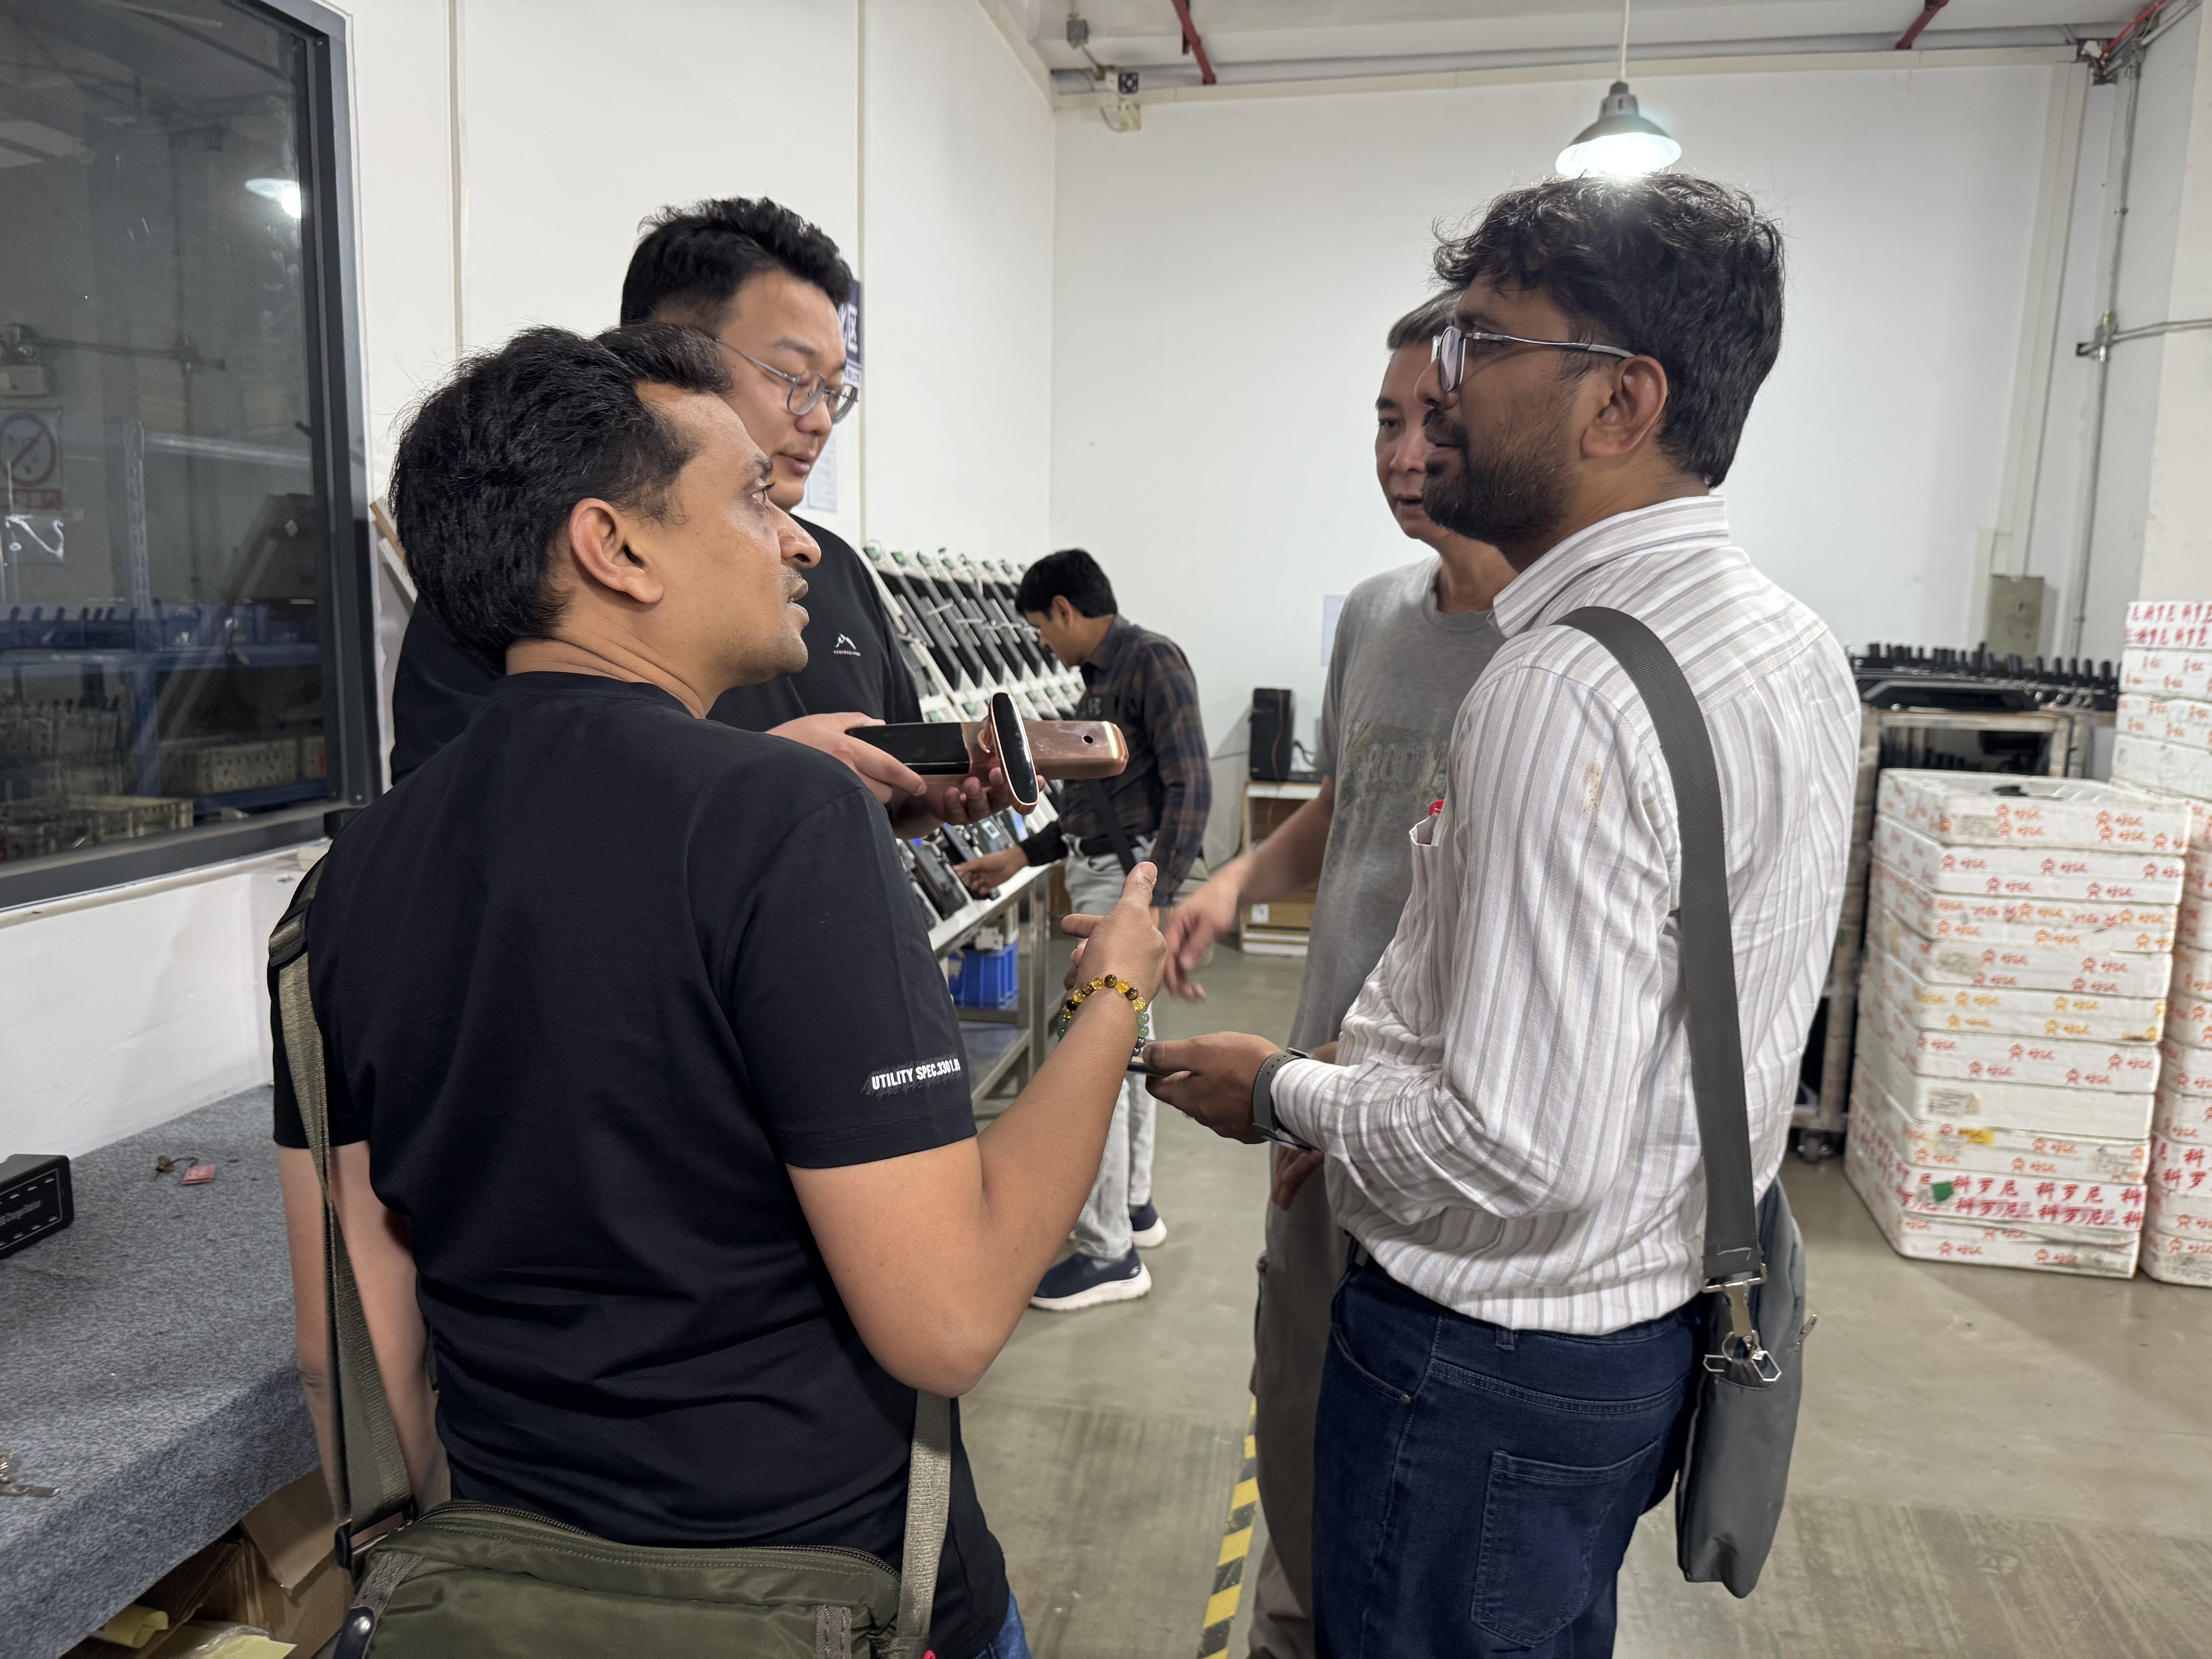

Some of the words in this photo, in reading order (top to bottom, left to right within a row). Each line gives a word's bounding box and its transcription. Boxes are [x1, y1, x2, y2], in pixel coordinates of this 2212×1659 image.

[871, 1068, 913, 1090] UTILITY
[2036, 1181, 2103, 1203] 科罗尼
